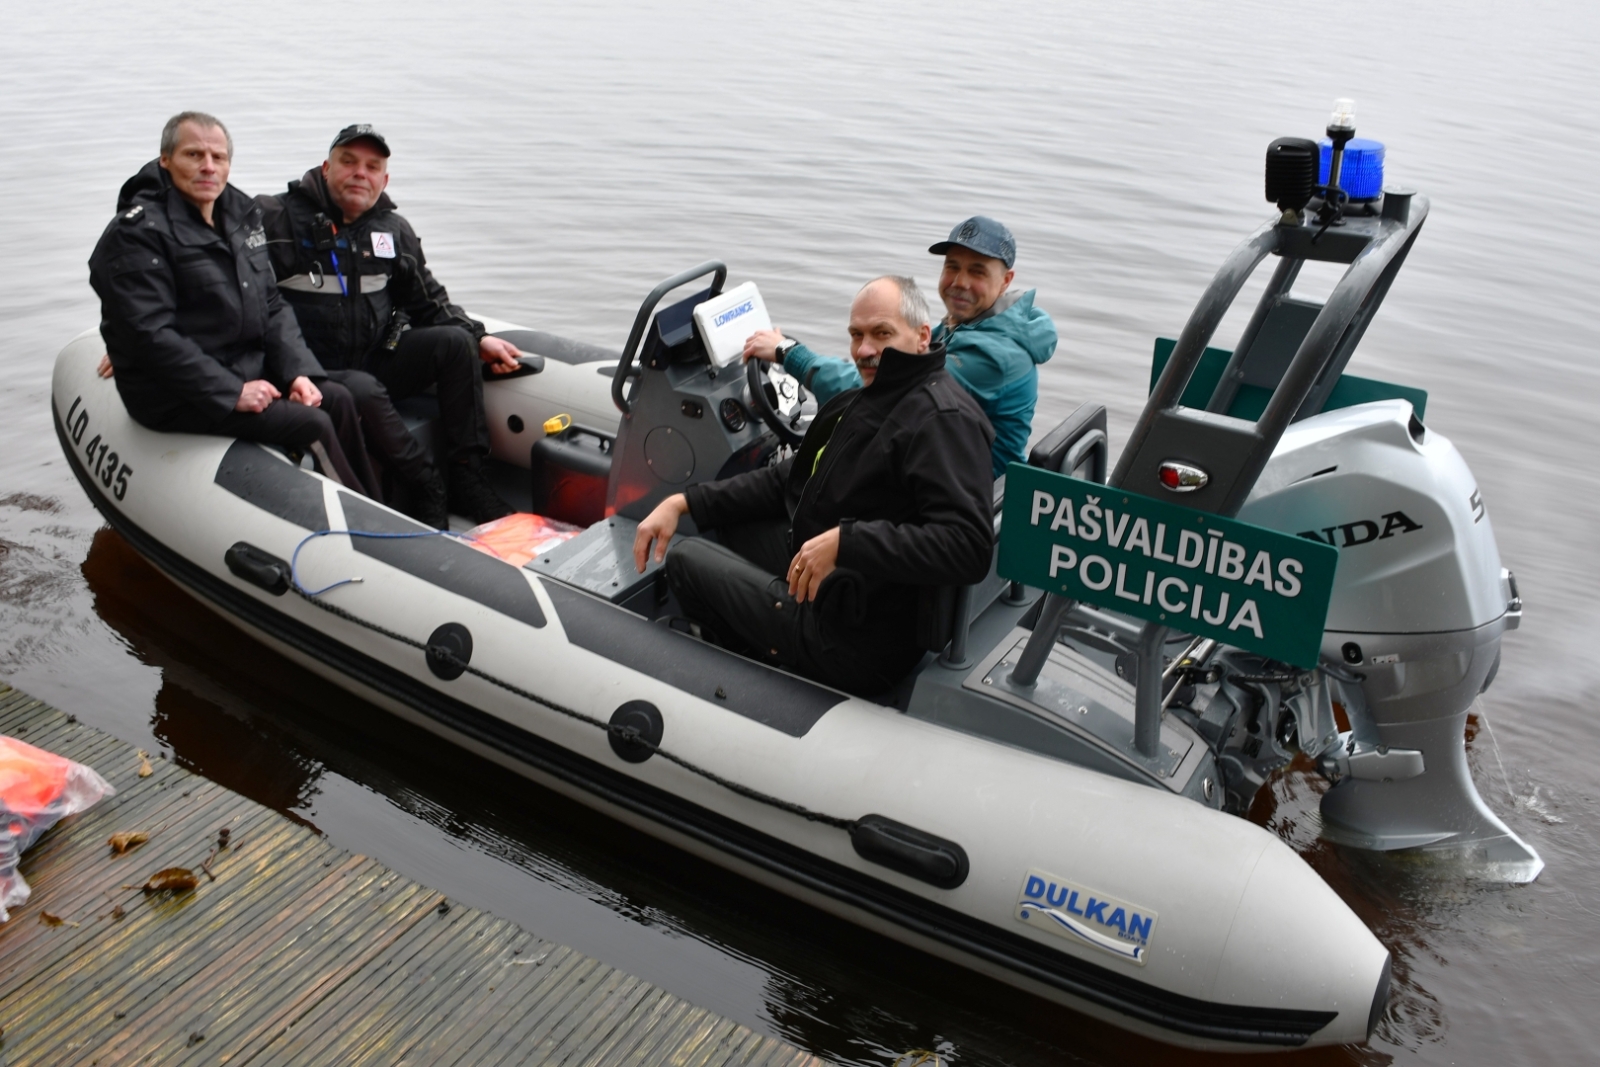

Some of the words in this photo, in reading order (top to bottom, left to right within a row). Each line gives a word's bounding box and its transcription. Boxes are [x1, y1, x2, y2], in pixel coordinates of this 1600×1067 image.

[714, 301, 754, 328] LOWRANCE
[85, 433, 134, 502] 4135
[1030, 489, 1303, 598] PAŠVALDĪBAS
[1296, 510, 1423, 550] NDA
[1049, 543, 1264, 640] POLICIJA
[1024, 874, 1153, 940] DULKAN
[1117, 930, 1147, 946] BOATS
